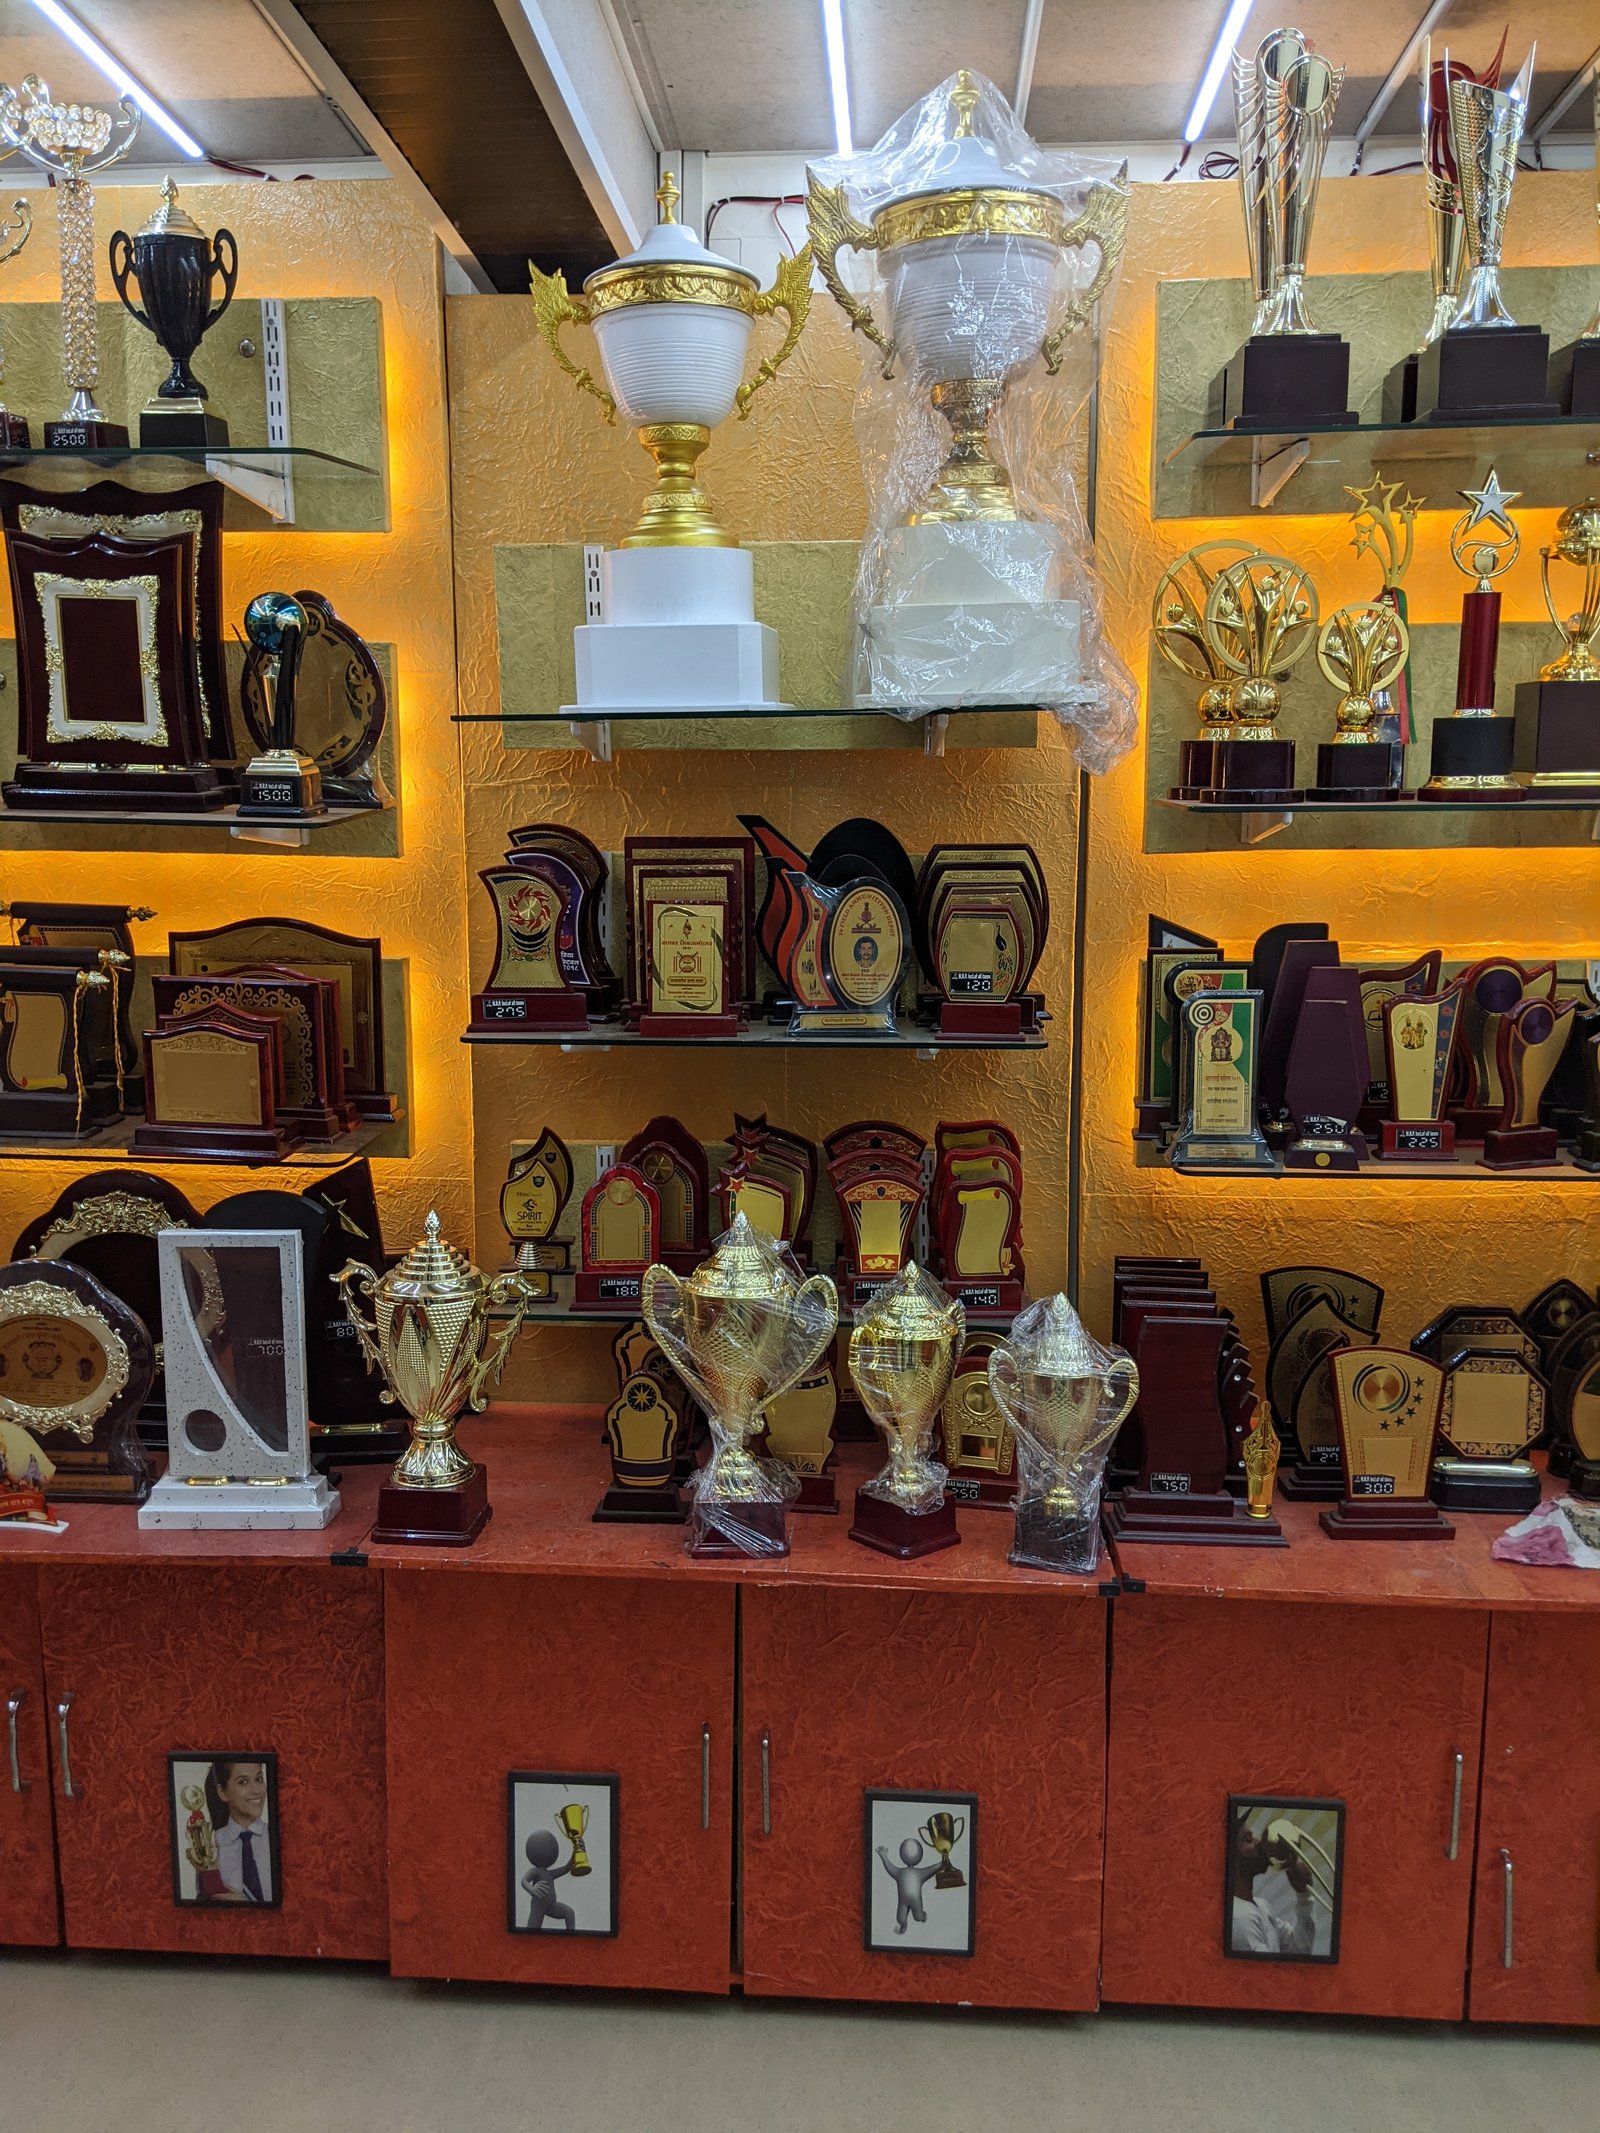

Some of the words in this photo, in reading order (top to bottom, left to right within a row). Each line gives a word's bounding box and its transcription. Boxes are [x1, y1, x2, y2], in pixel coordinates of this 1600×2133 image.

[53, 434, 86, 446] 2500
[259, 790, 291, 801] 1500
[967, 980, 991, 991] 120
[496, 1006, 525, 1018] 275
[1408, 1137, 1438, 1148] 225
[517, 1211, 543, 1221] SPIRIT
[616, 1286, 639, 1297] 180
[974, 1294, 997, 1305] 140
[258, 1345, 284, 1356] 700
[1162, 1481, 1188, 1492] 750
[1365, 1482, 1393, 1494] 300
